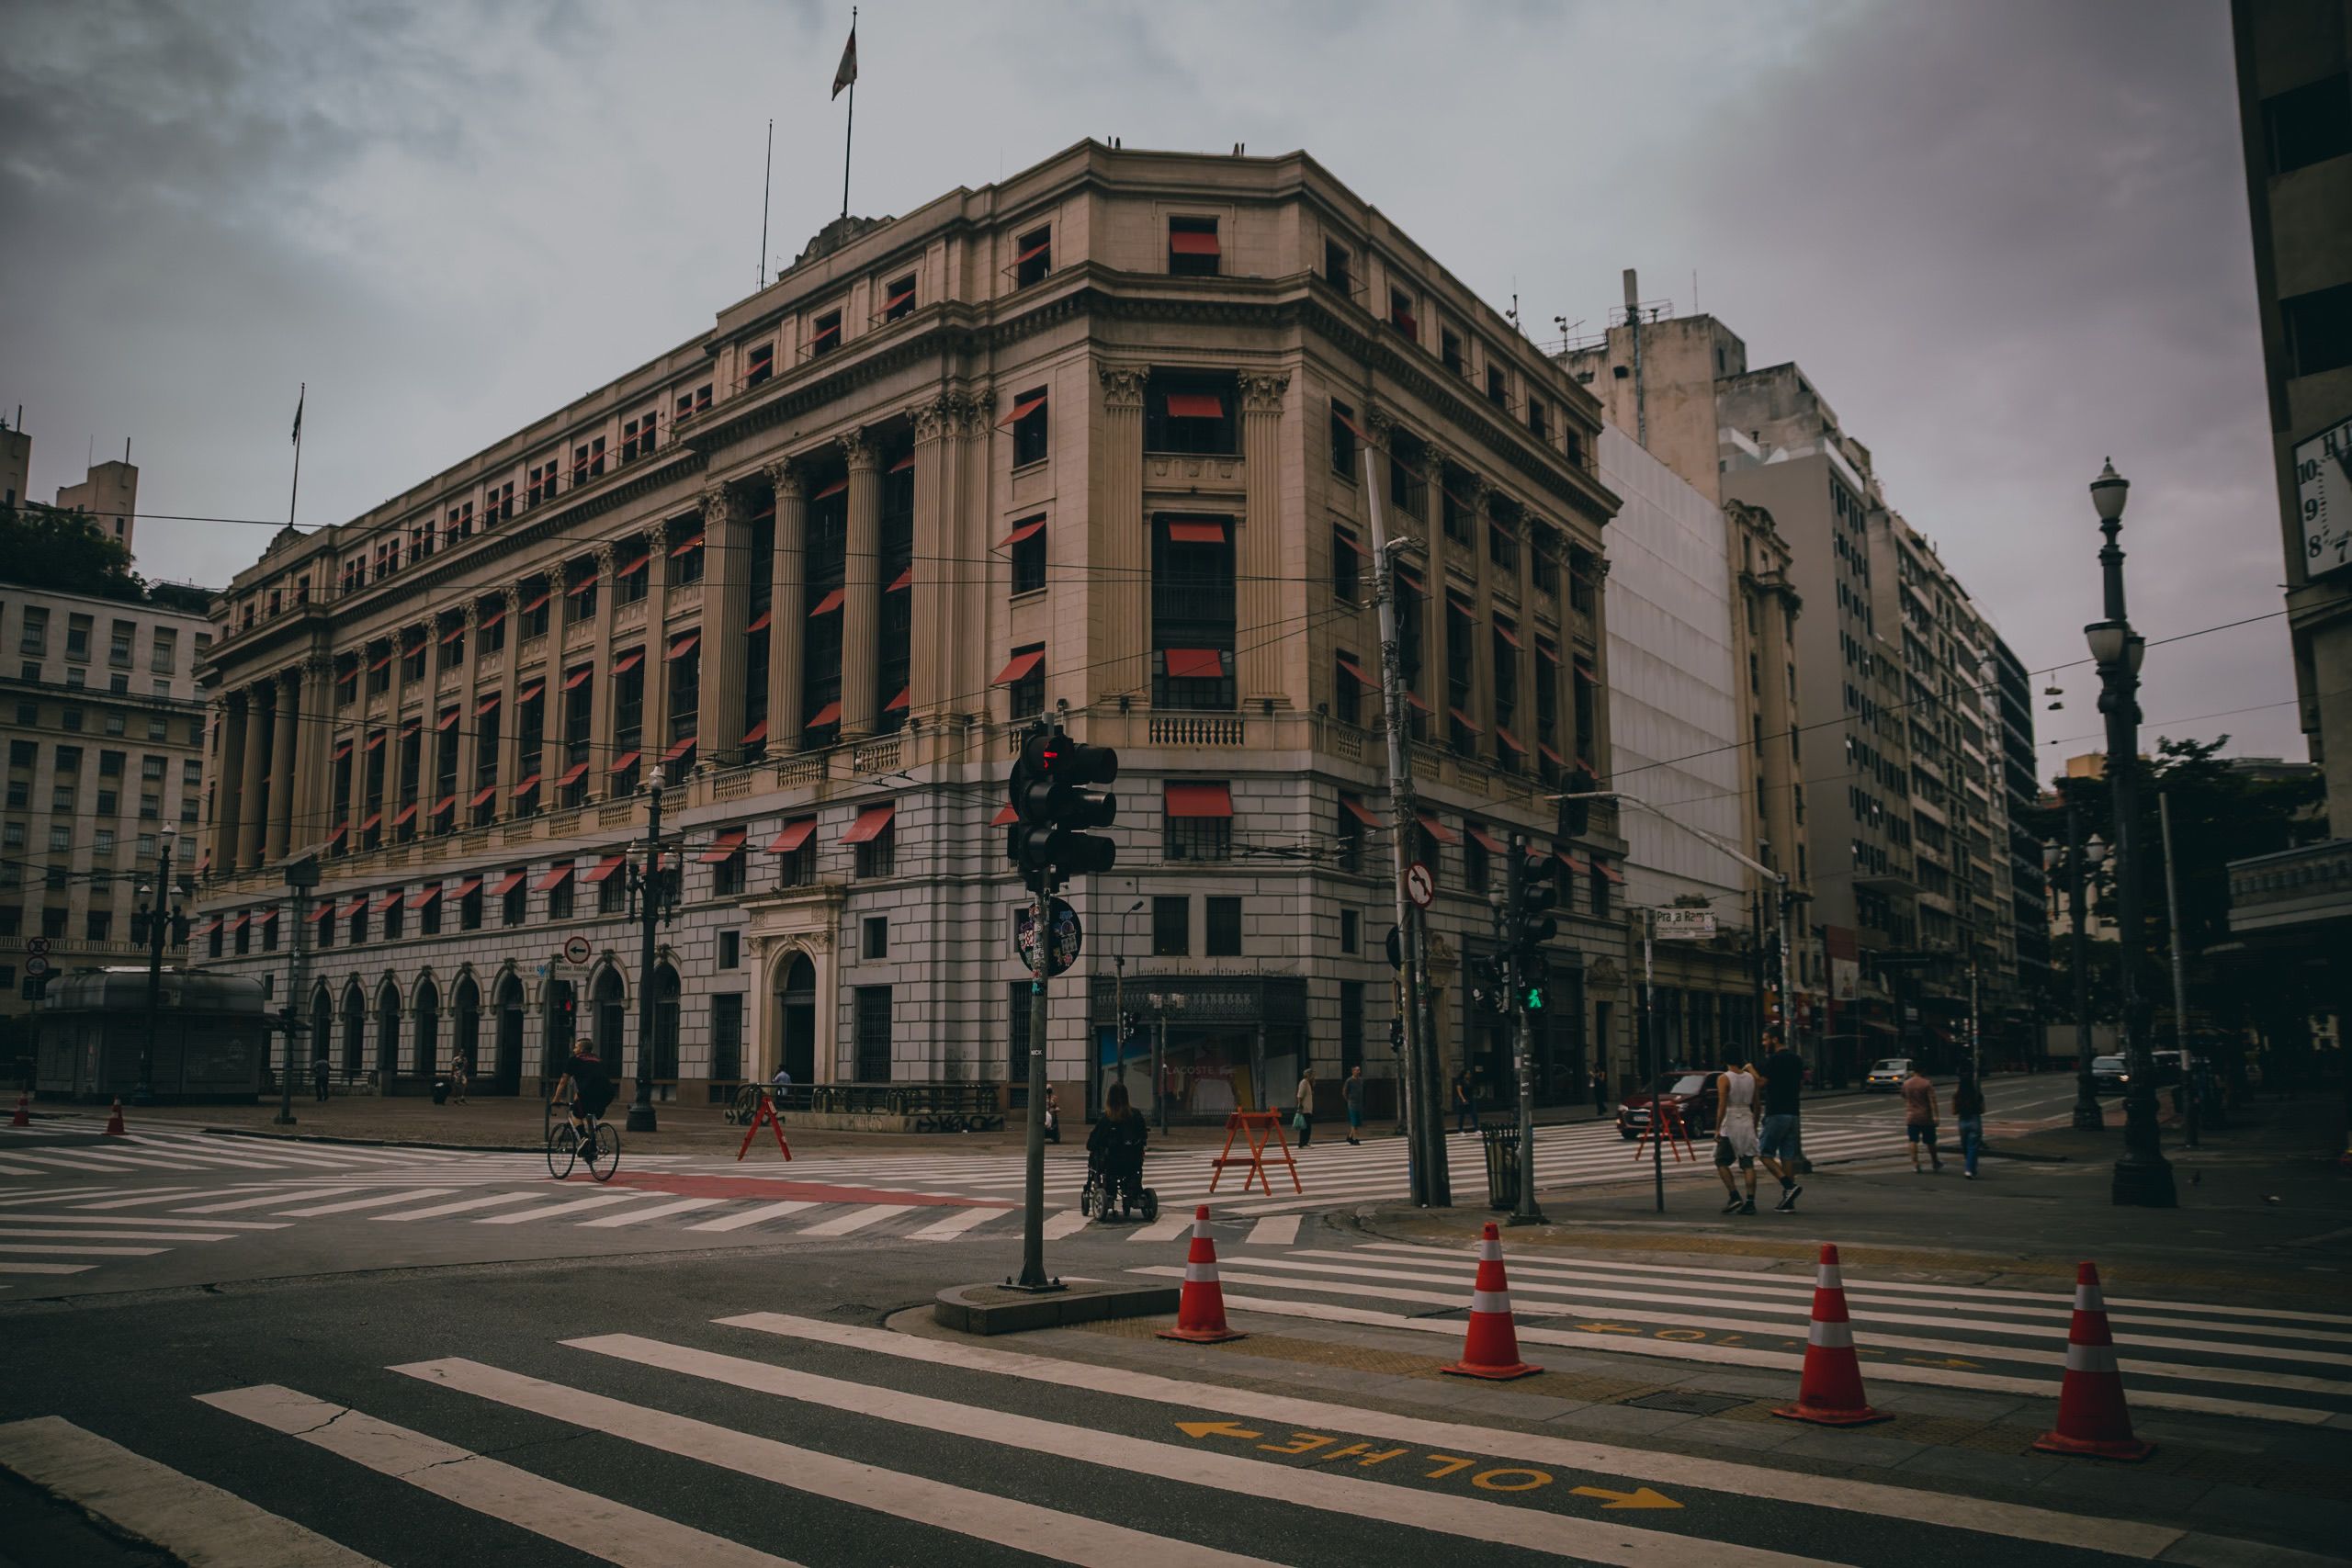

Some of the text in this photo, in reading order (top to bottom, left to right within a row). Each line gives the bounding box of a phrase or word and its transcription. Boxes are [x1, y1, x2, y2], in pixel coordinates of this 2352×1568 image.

[2298, 459, 2317, 485] 10
[2304, 498, 2318, 522] 9
[2309, 535, 2322, 558] 8
[2335, 539, 2347, 564] 7
[1657, 910, 1681, 925] Praa
[1255, 1432, 1554, 1492] OLHE
